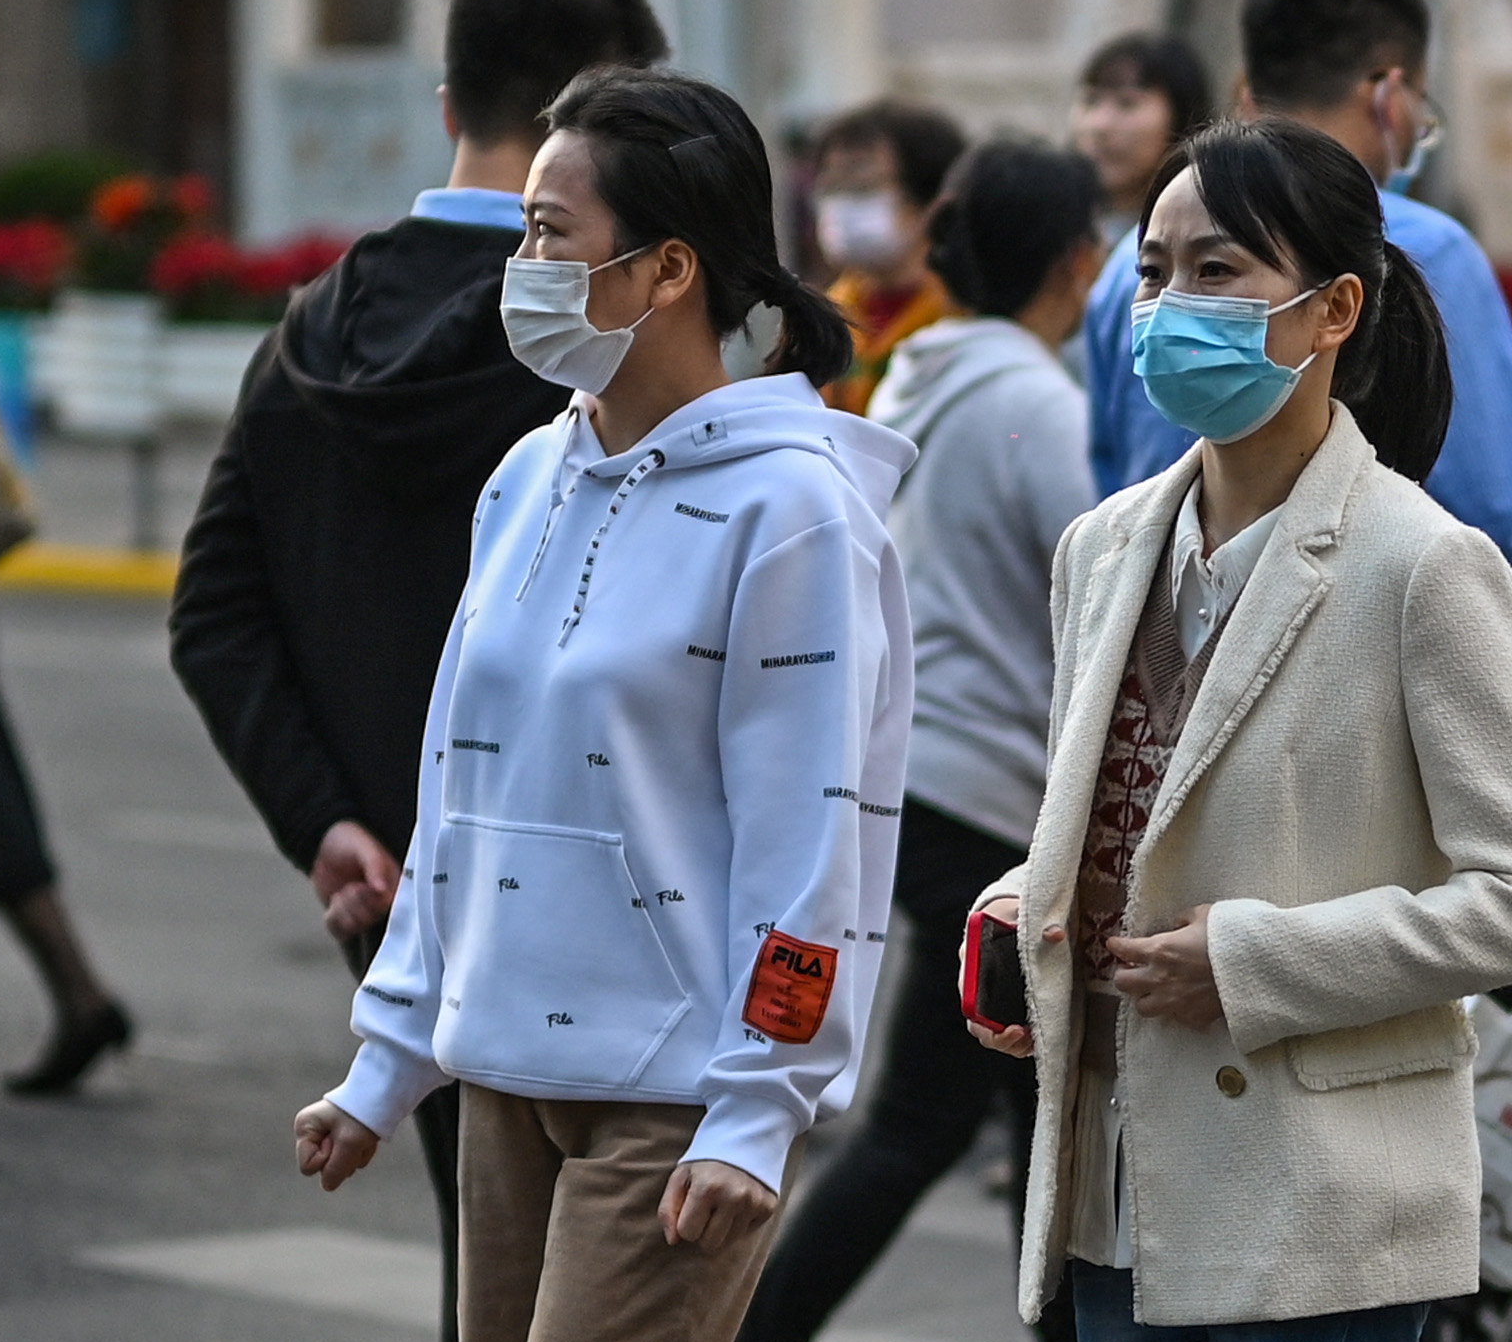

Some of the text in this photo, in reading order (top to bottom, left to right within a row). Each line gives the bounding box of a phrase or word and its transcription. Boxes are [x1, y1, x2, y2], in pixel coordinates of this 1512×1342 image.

[586, 752, 610, 768] Fila
[498, 876, 520, 893] Fila
[655, 889, 686, 906] Fila
[752, 921, 776, 938] Fil
[771, 945, 822, 978] FILA
[545, 1011, 575, 1029] Fila
